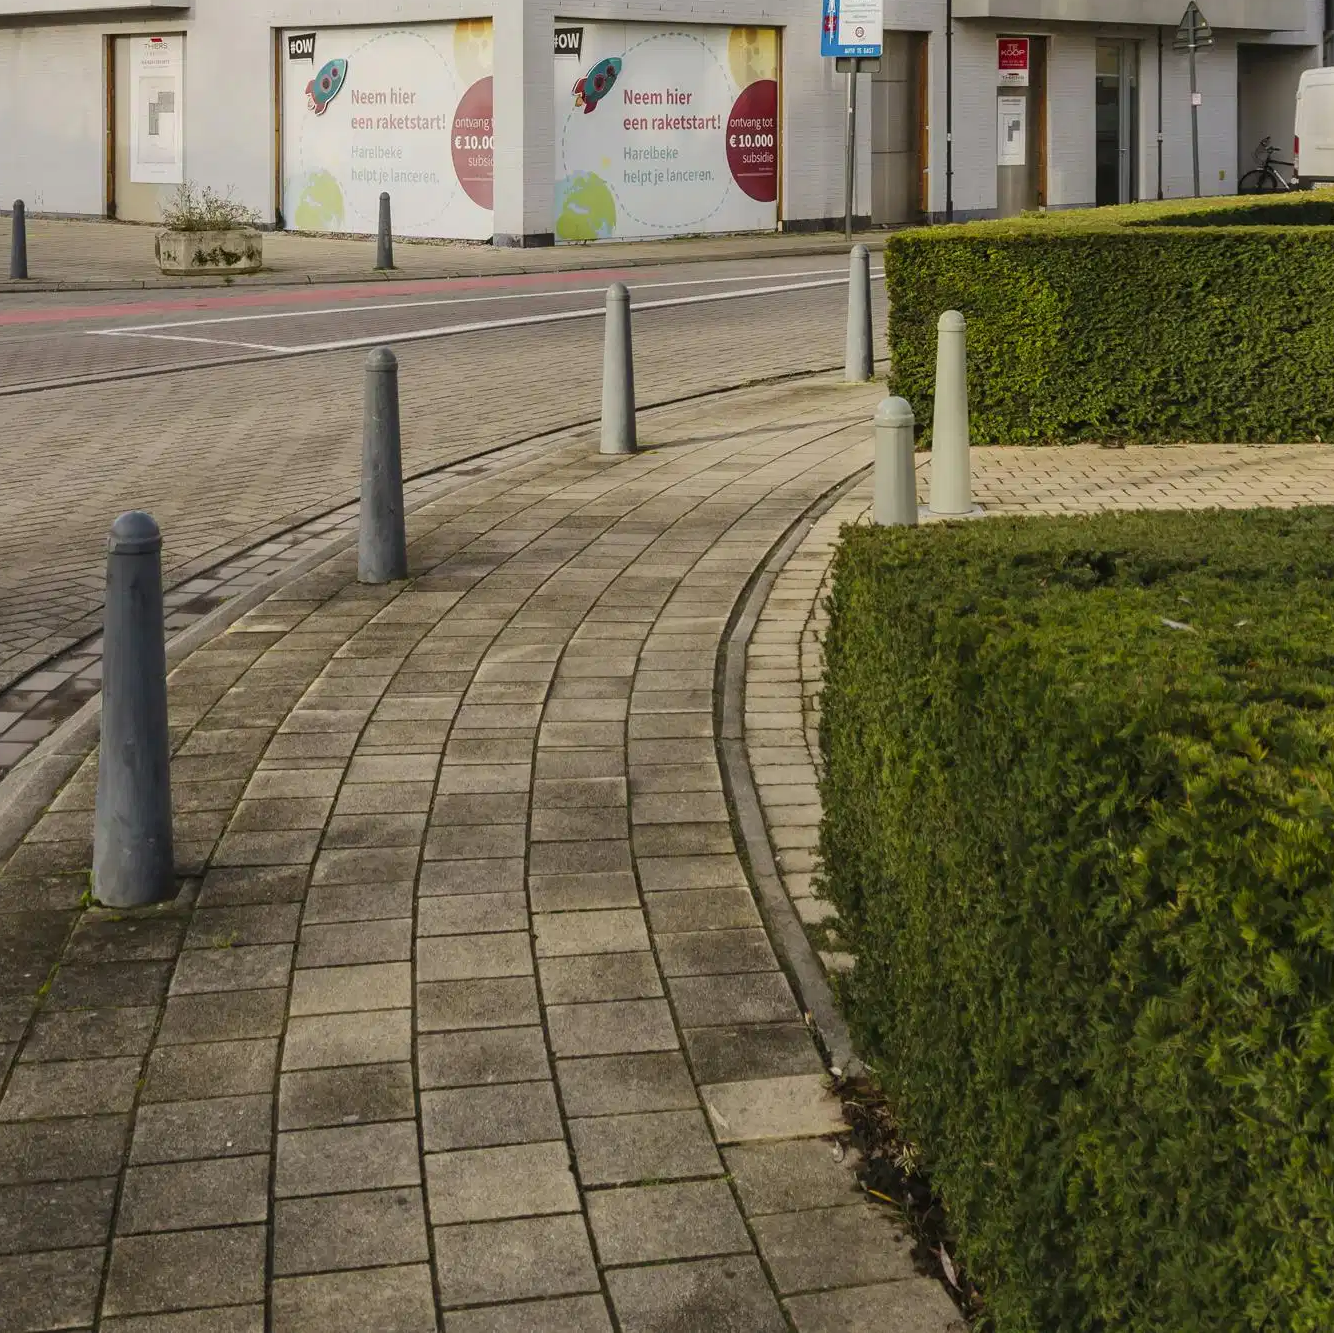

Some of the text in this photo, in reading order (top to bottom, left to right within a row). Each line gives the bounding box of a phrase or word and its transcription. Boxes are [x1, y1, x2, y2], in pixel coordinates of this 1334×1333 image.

[290, 39, 314, 54] #OW
[351, 87, 416, 105] Neem hier
[623, 88, 693, 105] Neem hier
[351, 114, 446, 130] een raketstart!
[455, 118, 490, 131] ontvang
[623, 114, 722, 130] een raketstart!
[730, 118, 773, 131] ontvang tot
[455, 136, 462, 150] €
[729, 134, 774, 148] € 10.000
[351, 146, 403, 159] Harelbeke
[623, 146, 679, 160] Harelbeke
[742, 152, 774, 163] subsidie
[351, 168, 440, 185] helpt je lanceren.
[623, 168, 715, 186] helpt je lanceren.
